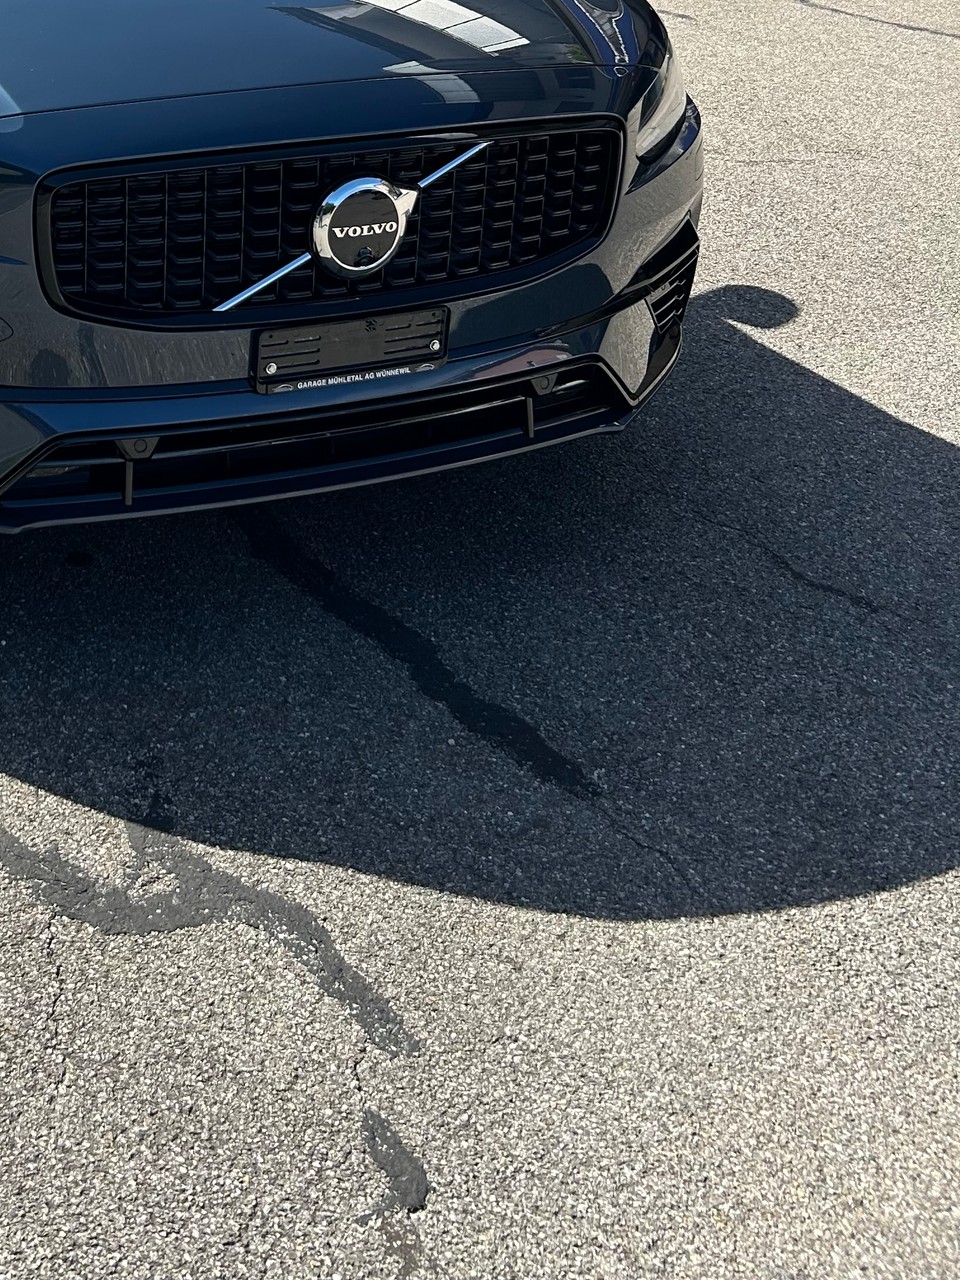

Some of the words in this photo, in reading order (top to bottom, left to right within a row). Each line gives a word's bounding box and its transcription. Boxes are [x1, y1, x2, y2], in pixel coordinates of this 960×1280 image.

[331, 221, 398, 238] VOLVO
[297, 379, 327, 389] GARAGE
[327, 375, 364, 385] MÜHLETAL
[364, 372, 375, 380] AG
[375, 367, 411, 378] WÜNNEWIL
